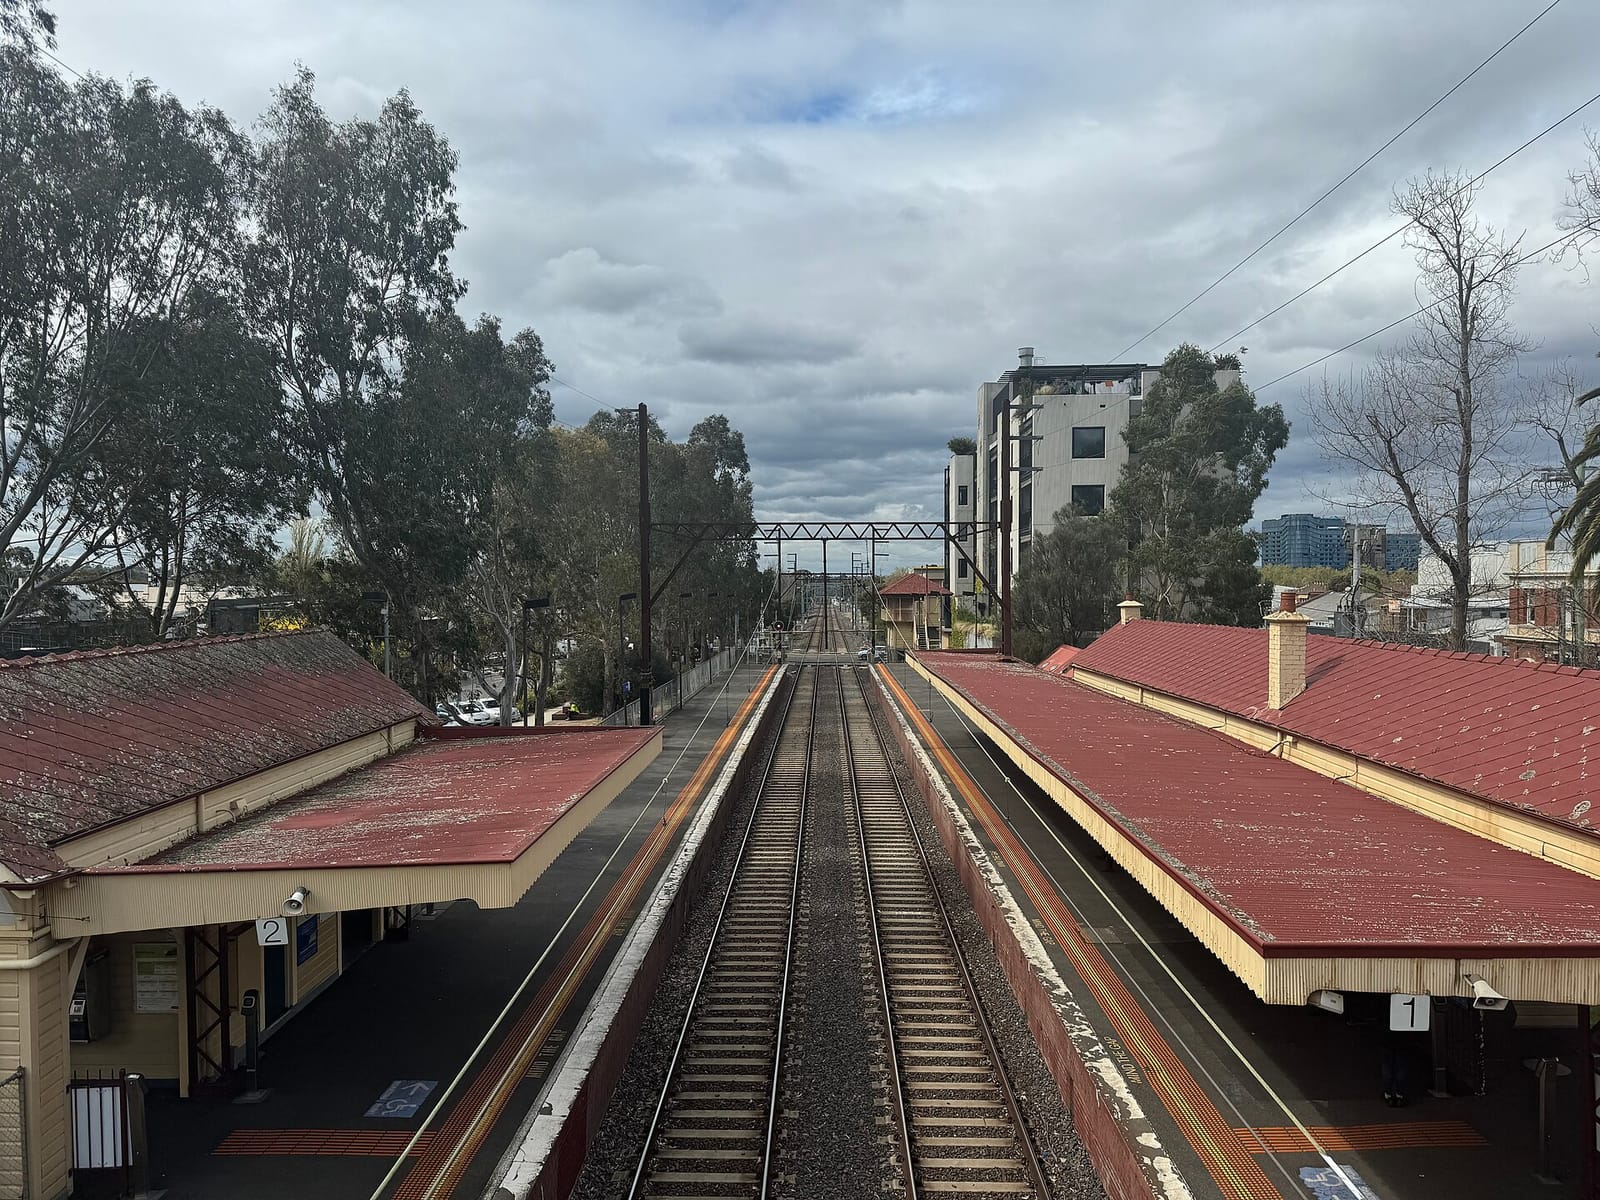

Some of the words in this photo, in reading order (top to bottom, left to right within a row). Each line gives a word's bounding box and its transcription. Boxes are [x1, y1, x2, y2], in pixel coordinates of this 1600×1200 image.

[263, 920, 282, 943] 2
[1402, 997, 1415, 1028] 1
[1103, 1036, 1121, 1051] GAP
[1112, 1050, 1130, 1063] THE
[1121, 1063, 1143, 1085] MIND
